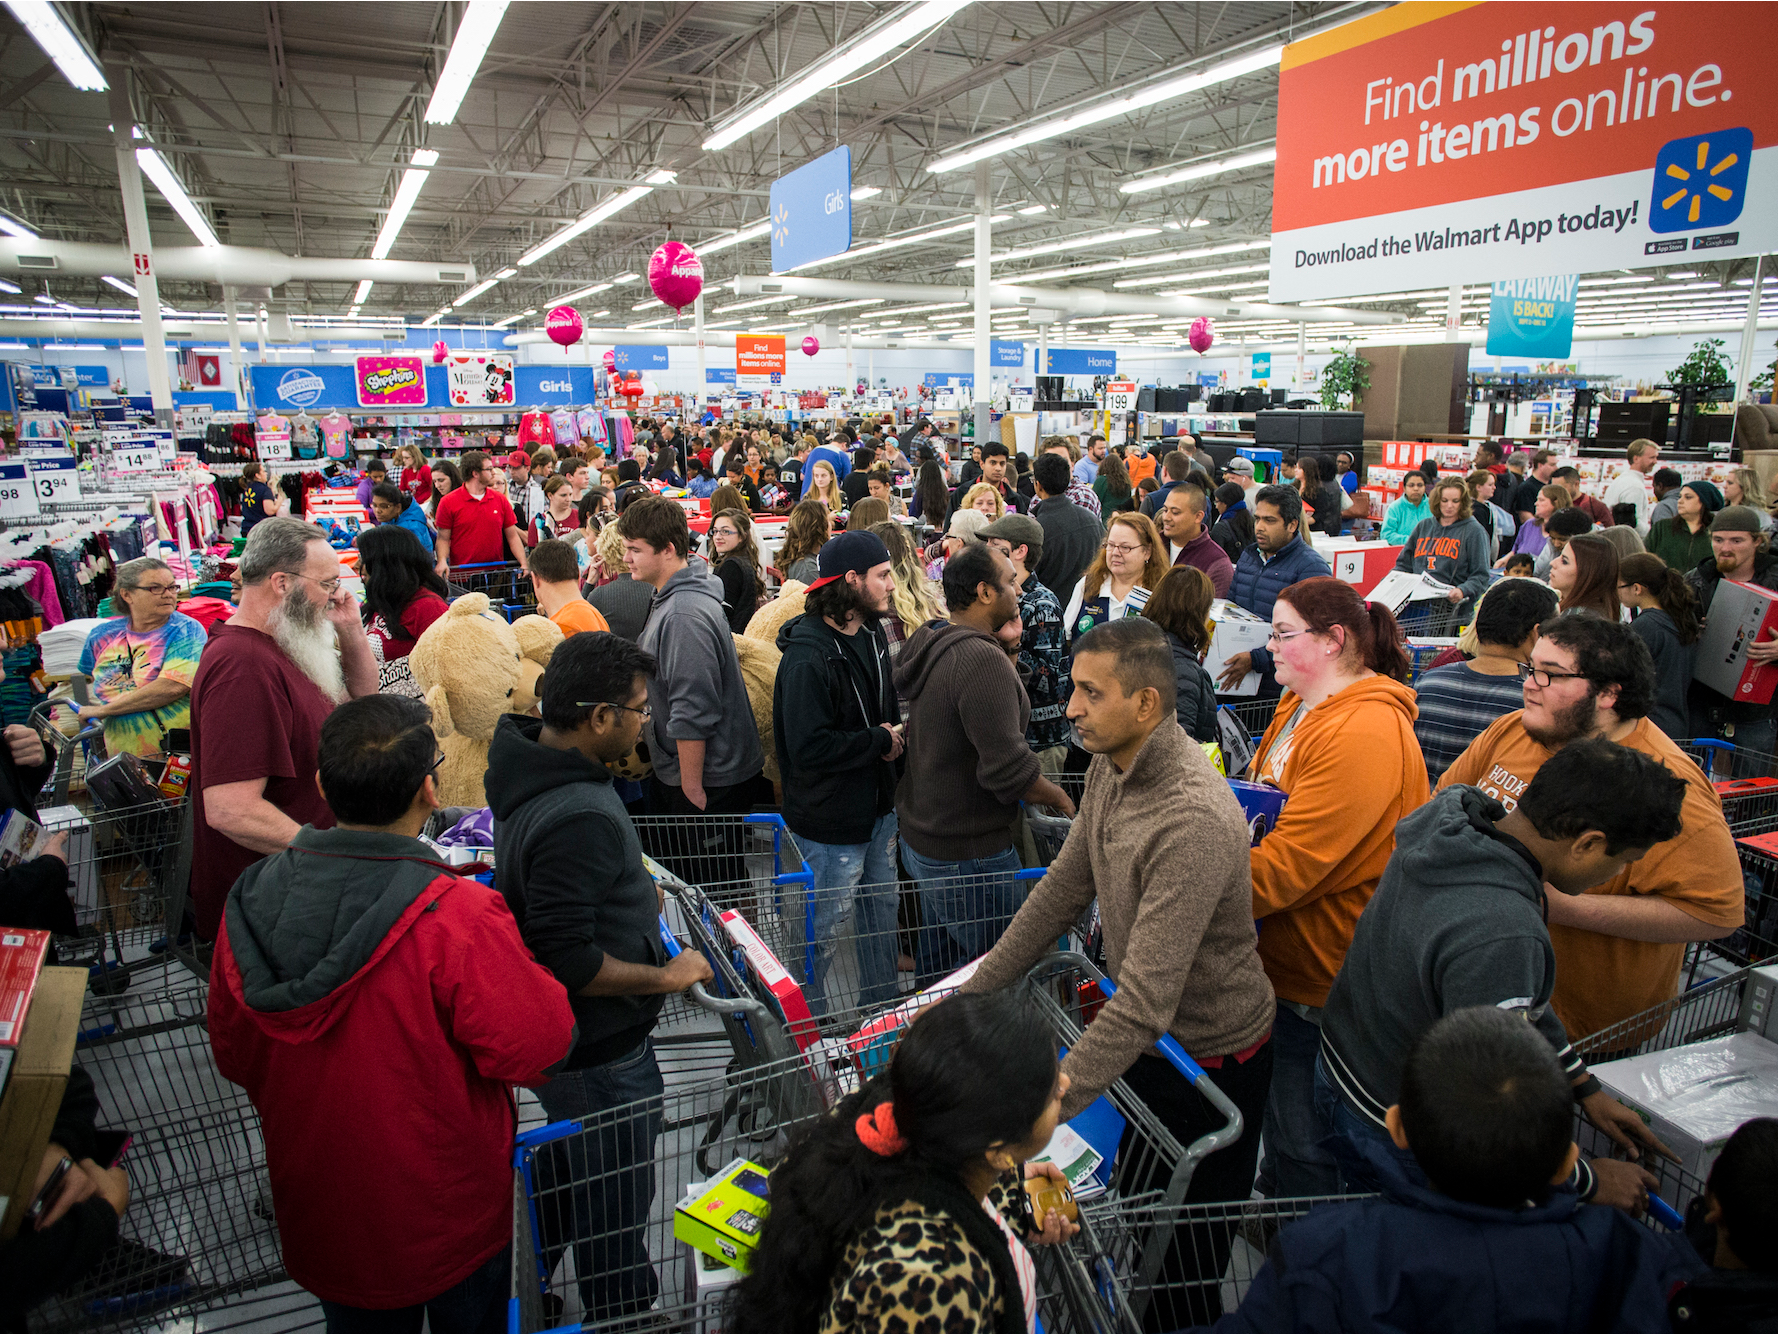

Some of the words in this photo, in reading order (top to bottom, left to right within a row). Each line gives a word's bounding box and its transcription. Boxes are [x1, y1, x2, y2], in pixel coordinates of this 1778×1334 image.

[1364, 59, 1444, 125] Find
[1452, 11, 1657, 103] millions
[1312, 136, 1409, 188] more
[1416, 106, 1541, 168] items
[1551, 63, 1732, 137] online.
[824, 189, 844, 215] Girls
[1294, 239, 1379, 269] Download
[1382, 233, 1412, 257] the
[1415, 224, 1501, 252] Walmart
[1504, 217, 1553, 247] App
[1557, 200, 1640, 237] today!
[1494, 274, 1577, 302] LAYAWAY
[1513, 300, 1523, 316] IS
[1523, 301, 1555, 318] BACK!
[653, 355, 666, 363] Boys
[998, 347, 1017, 355] Storage
[1001, 354, 1021, 362] Laundry
[1088, 357, 1113, 367] Home
[365, 369, 415, 390] Shopkins
[539, 381, 573, 393] Girls
[1414, 537, 1461, 559] ILLINOIS
[1345, 562, 1355, 574] $9
[1488, 764, 1529, 797] HOOK
[746, 942, 767, 964] COLOR
[760, 958, 777, 976] ART
[1073, 1158, 1099, 1181] BLACK
